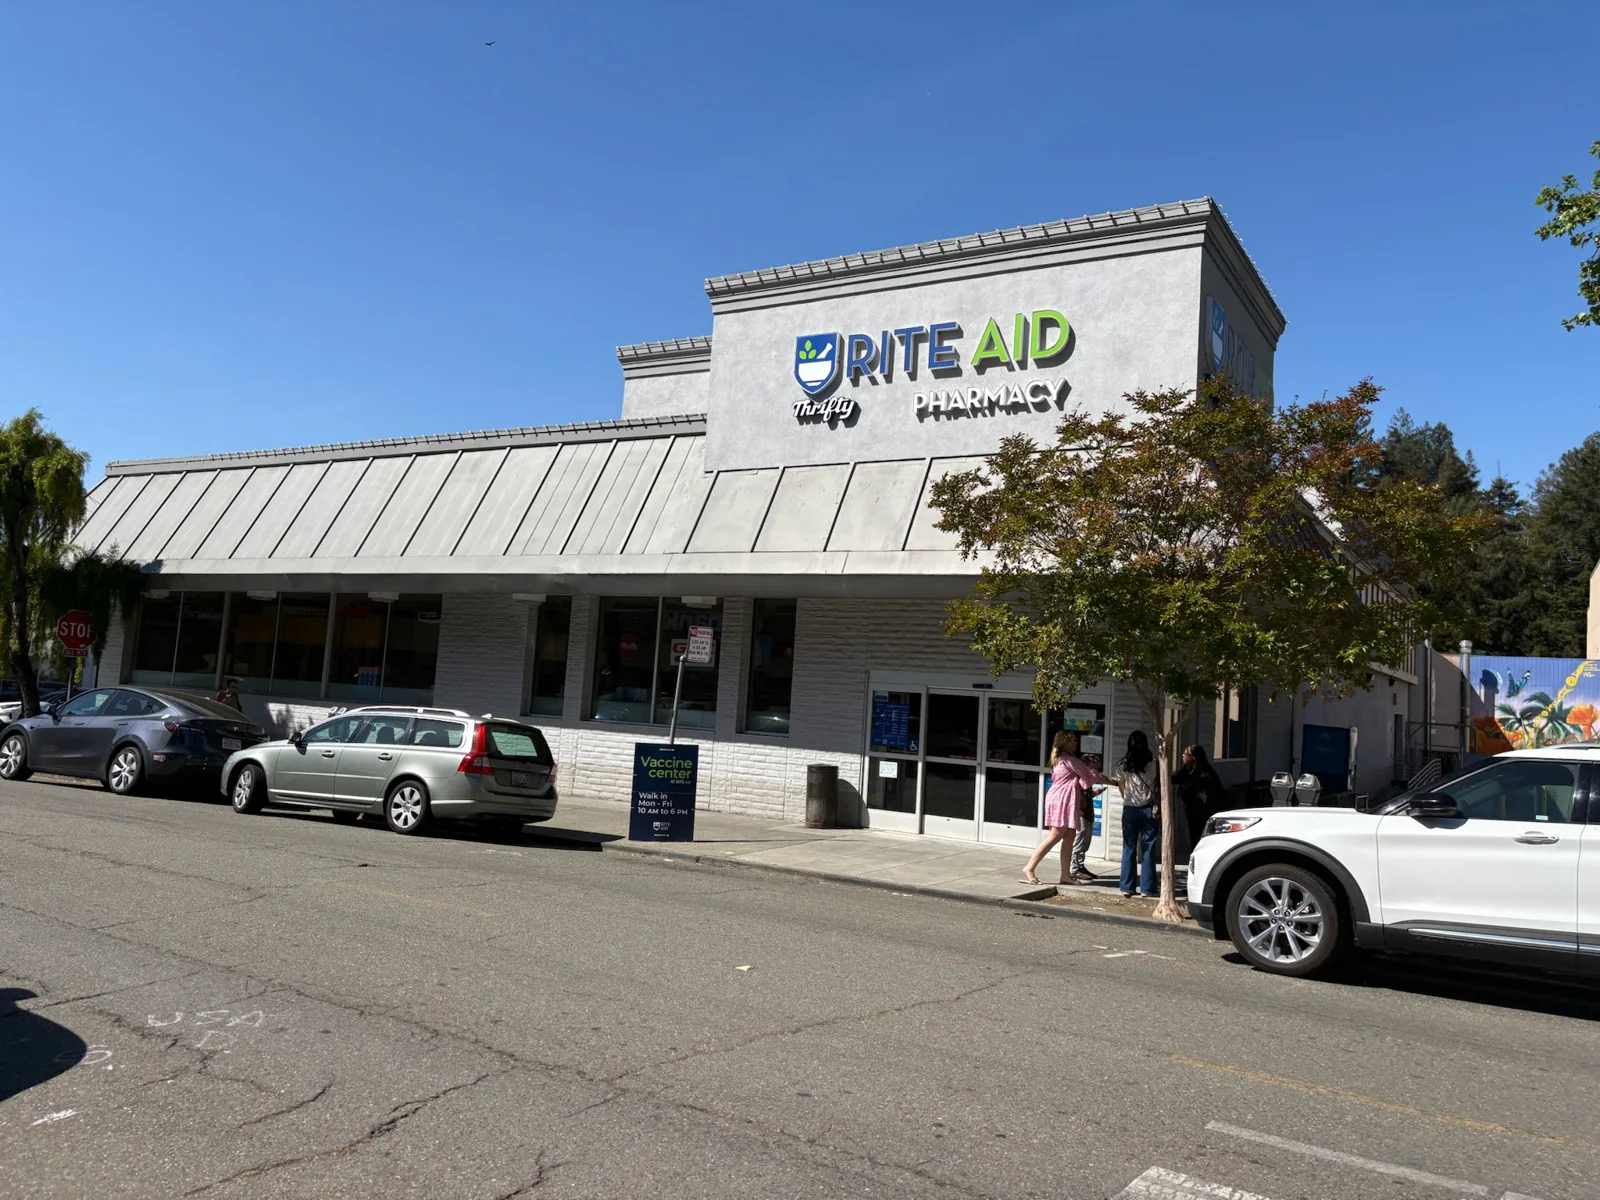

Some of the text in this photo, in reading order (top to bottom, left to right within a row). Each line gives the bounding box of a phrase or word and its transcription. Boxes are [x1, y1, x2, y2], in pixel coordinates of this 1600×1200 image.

[846, 309, 1070, 379] RITE AID
[913, 377, 1067, 414] PHARMACY
[792, 397, 855, 421] Thrifty
[640, 756, 692, 768] Vaccine
[648, 769, 692, 779] center
